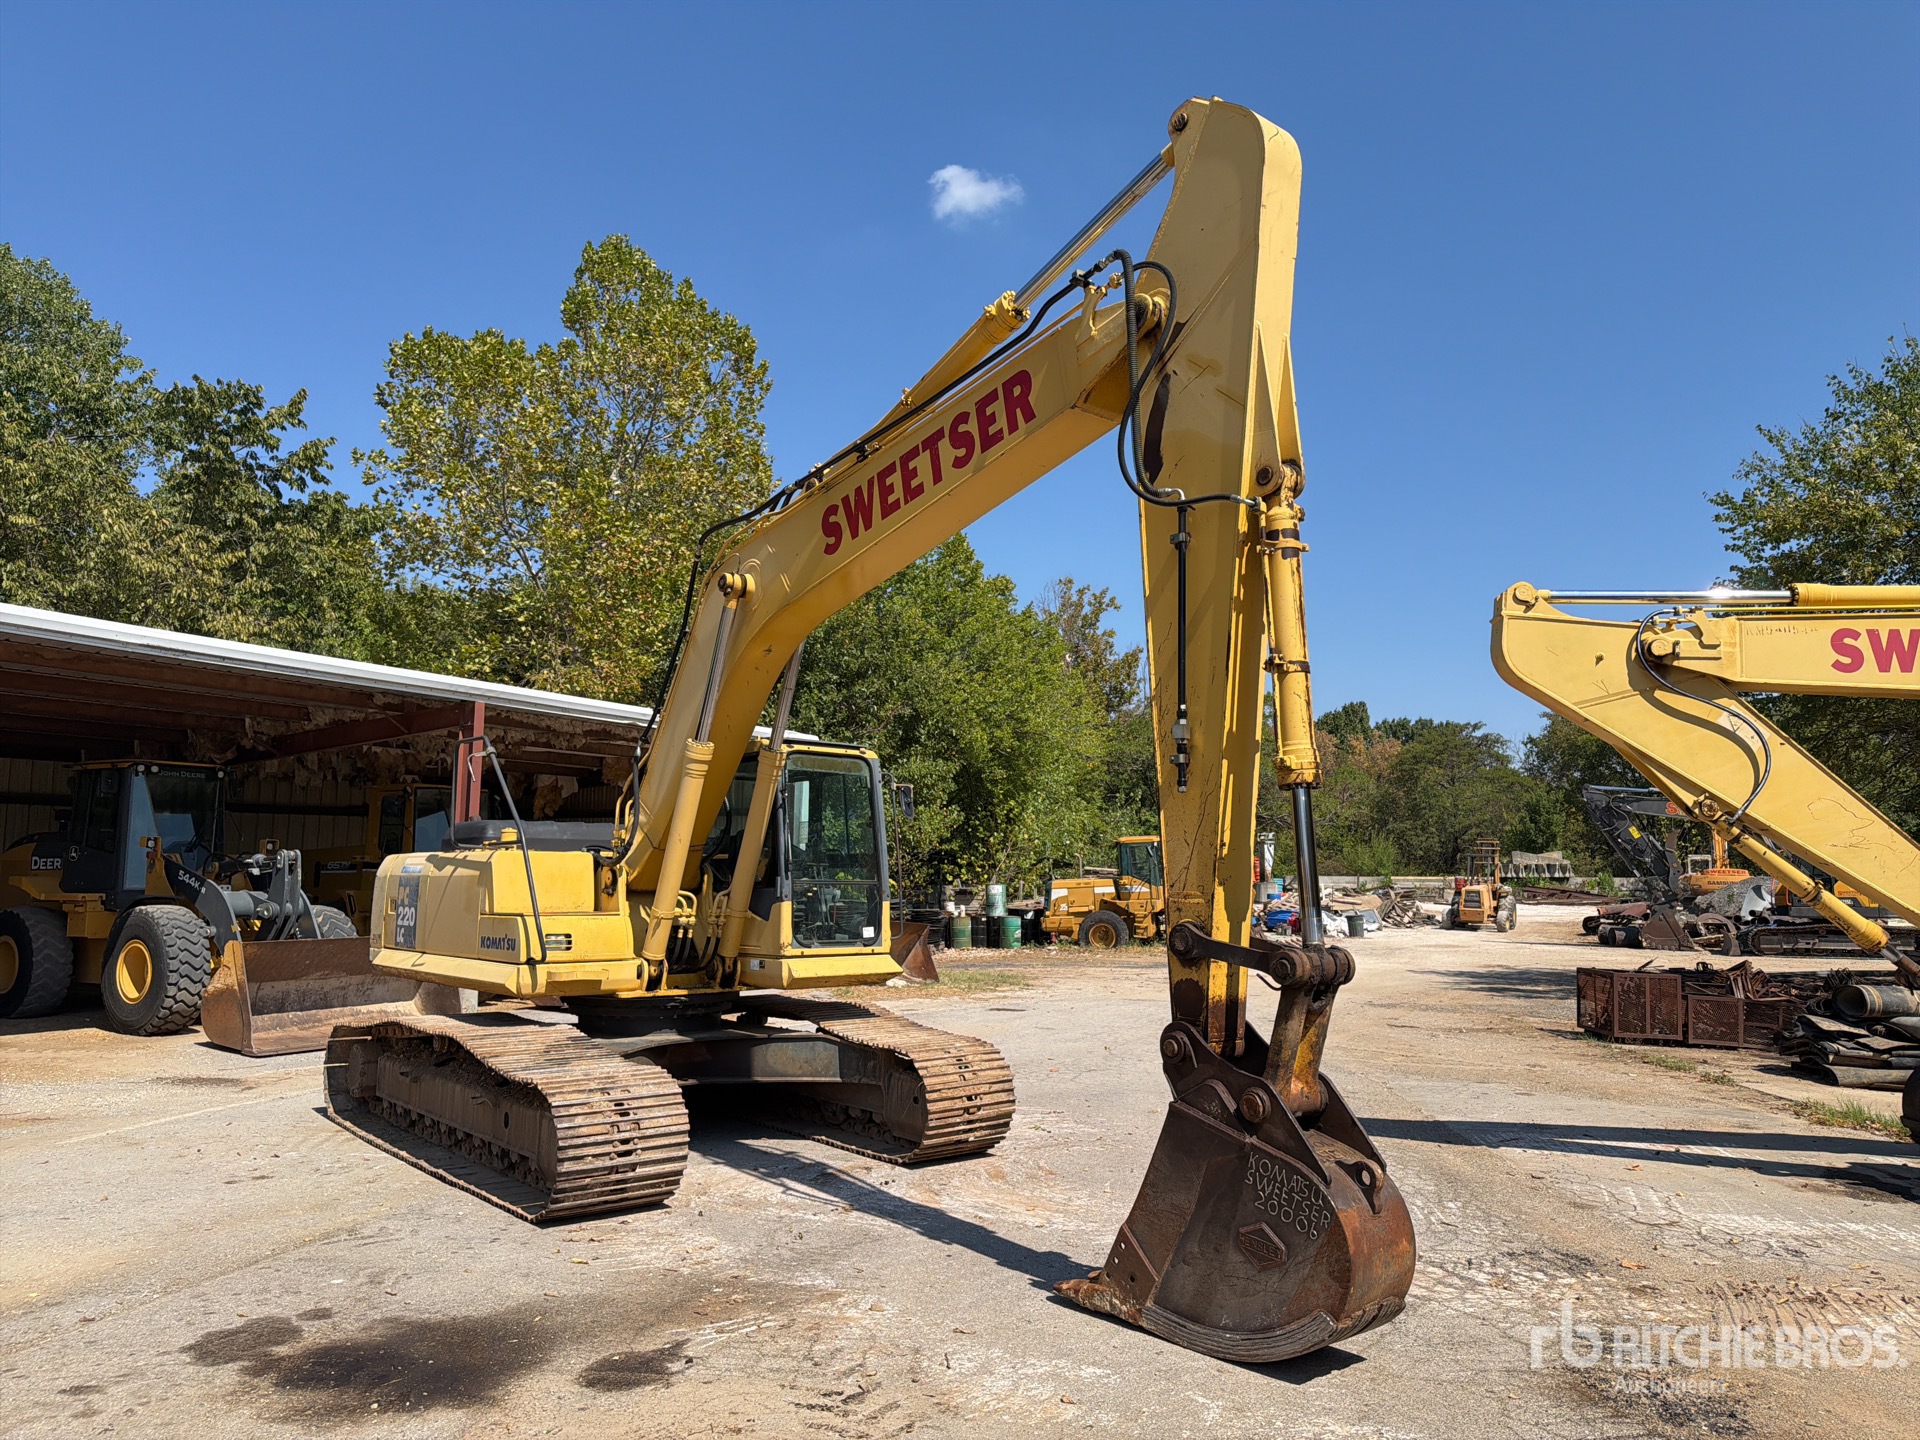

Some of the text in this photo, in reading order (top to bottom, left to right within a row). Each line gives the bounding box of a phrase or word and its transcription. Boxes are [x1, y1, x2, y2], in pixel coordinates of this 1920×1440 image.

[821, 369, 1037, 556] SWEETSER
[1830, 627, 1920, 673] SW
[158, 769, 207, 779] JOHN DEERE
[31, 856, 62, 870] DEER
[397, 906, 415, 927] 220
[396, 927, 405, 943] LC
[480, 933, 516, 951] KOMATSU
[1248, 1151, 1324, 1207] KOMATSU
[1244, 1169, 1331, 1229] SWEETSER
